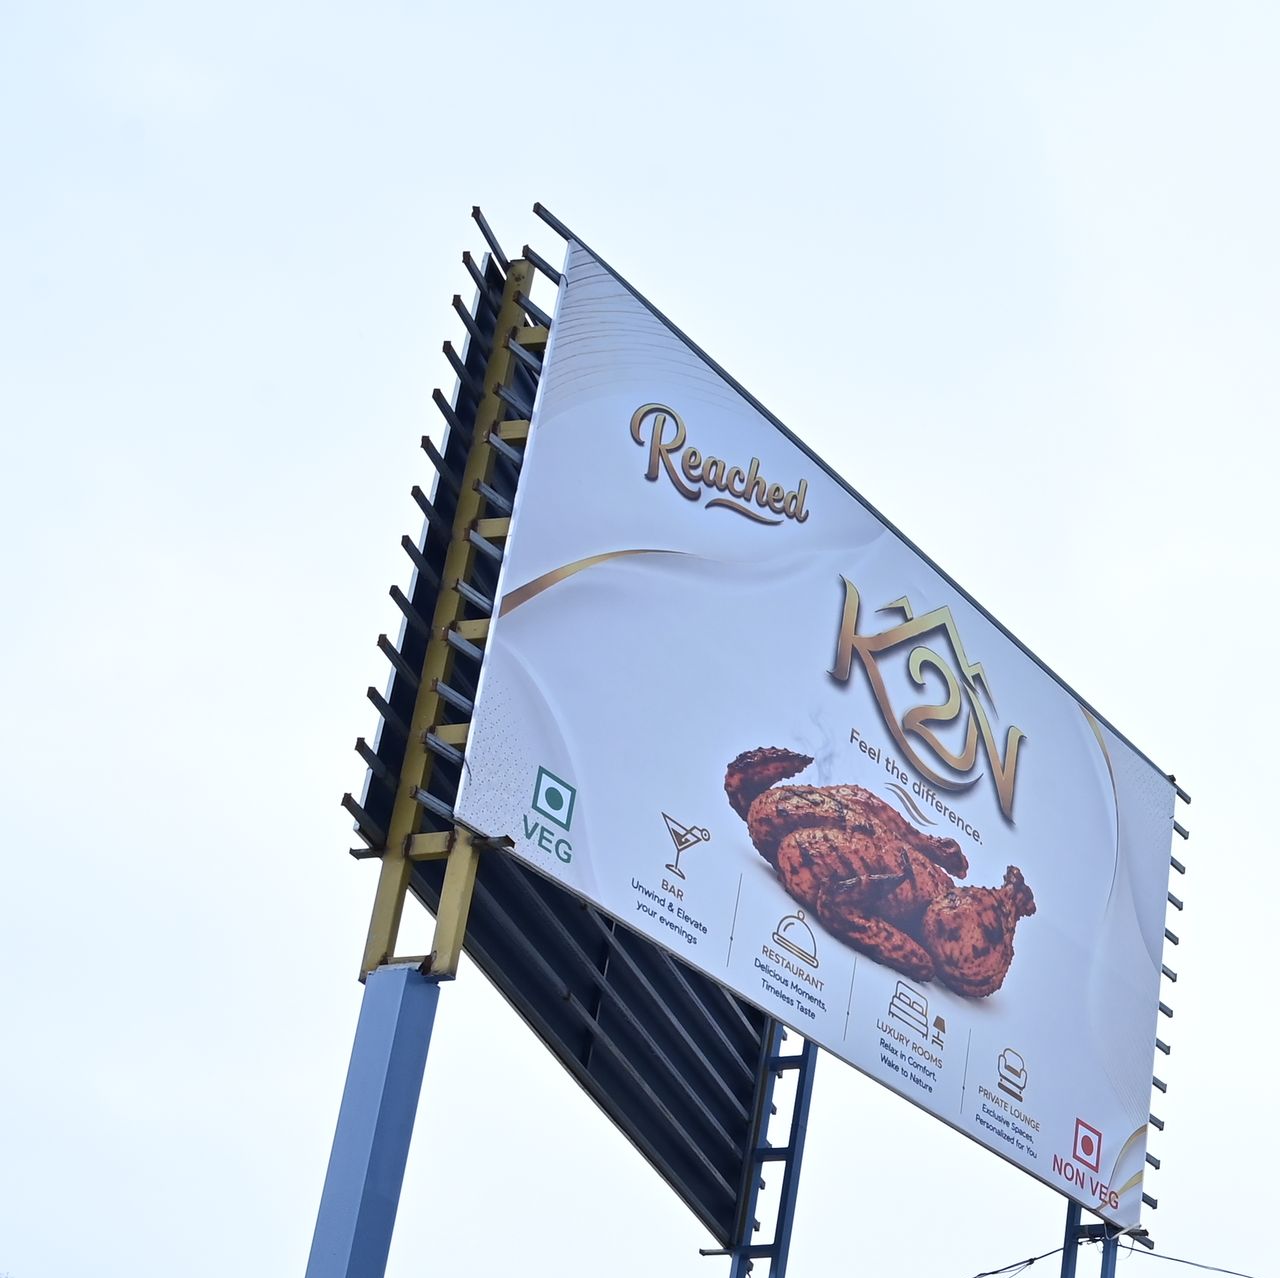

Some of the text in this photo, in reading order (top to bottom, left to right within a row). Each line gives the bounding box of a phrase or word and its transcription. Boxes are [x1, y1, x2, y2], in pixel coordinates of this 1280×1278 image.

[630, 403, 809, 523] Reached
[849, 728, 983, 845] Feel the difference.
[523, 814, 573, 864] VEG
[632, 877, 708, 934] Unwind & Elevate
[661, 879, 684, 901] BAR
[636, 900, 697, 945] your evenings
[754, 958, 827, 1012] Delicious Moments,
[762, 945, 824, 991] RESTAURANT
[761, 978, 816, 1020] Timeless Taste
[877, 1018, 943, 1069] LUXURY ROOMS
[880, 1038, 937, 1082] Relax in Comfort,
[880, 1053, 933, 1093] Wake to Nature
[978, 1085, 1040, 1132] PRIVATE LOUNGE
[982, 1103, 1010, 1128] Exclusive
[975, 1113, 1038, 1158] Personalized for You
[1053, 1154, 1119, 1210] NON VEG
